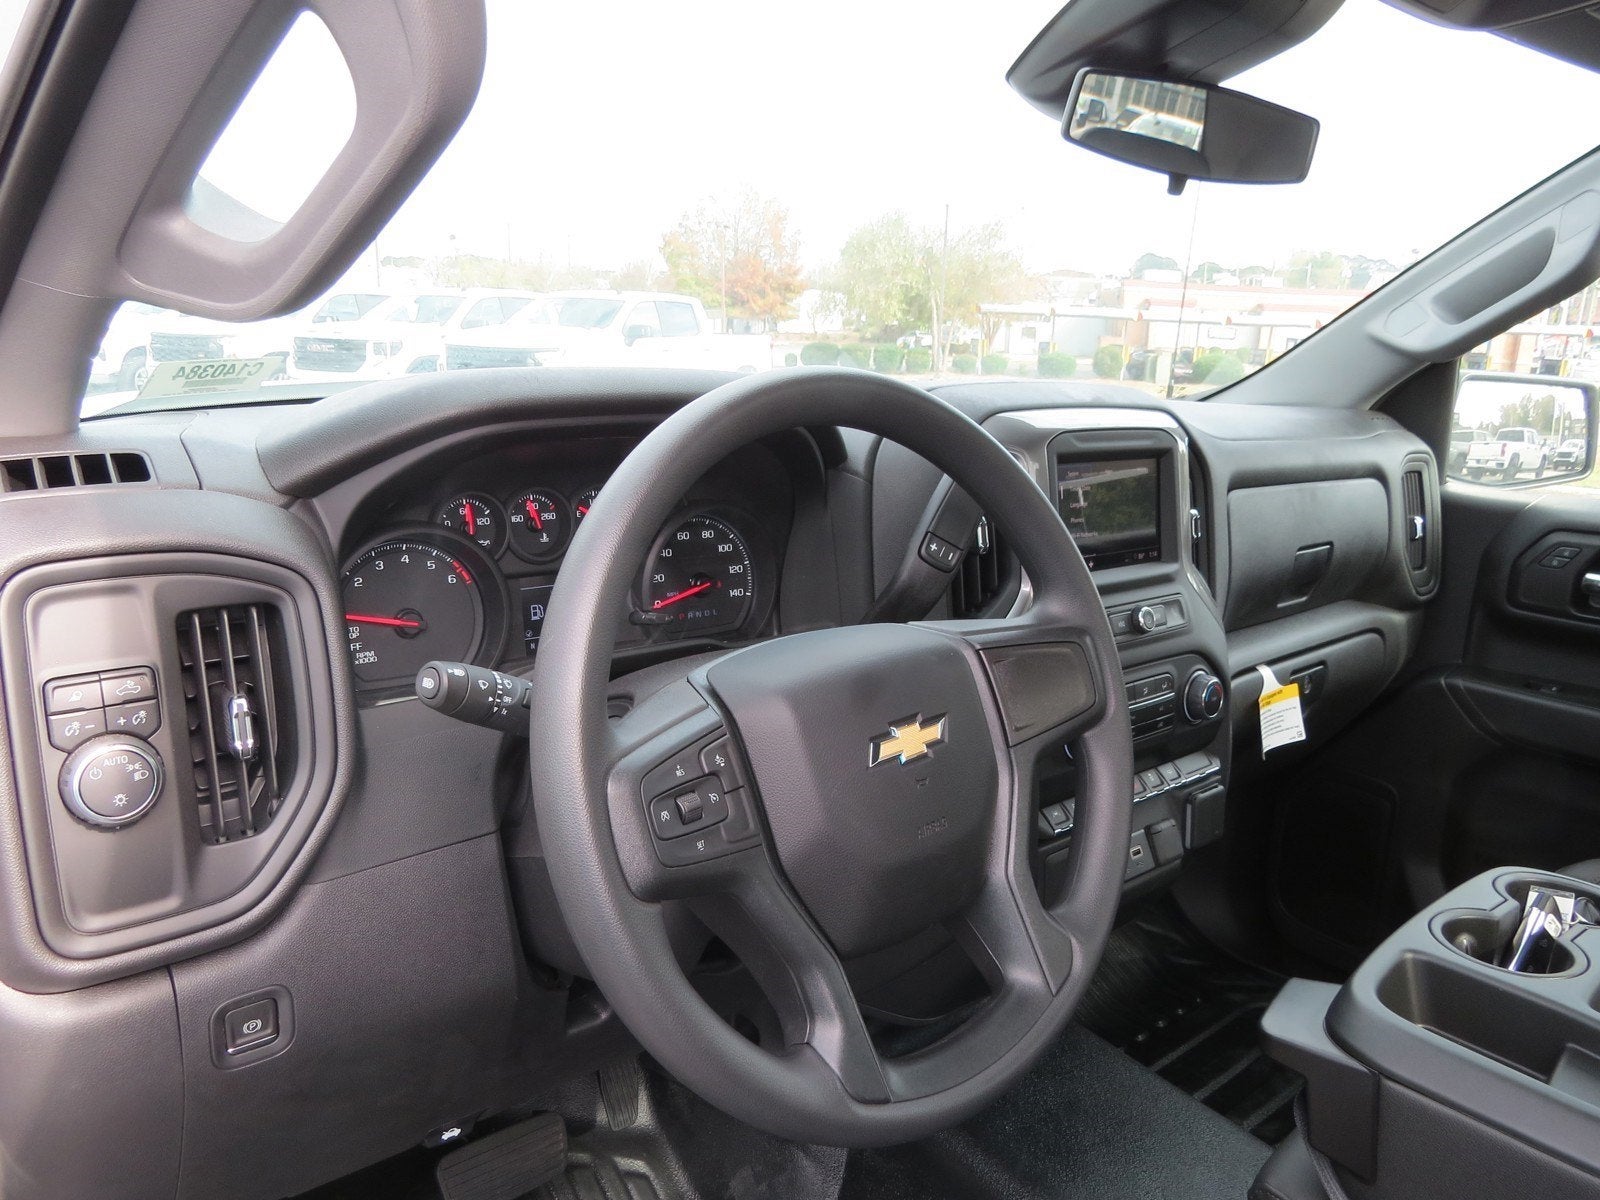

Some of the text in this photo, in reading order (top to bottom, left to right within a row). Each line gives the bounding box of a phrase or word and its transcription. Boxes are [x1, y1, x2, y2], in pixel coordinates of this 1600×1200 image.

[511, 514, 524, 522] 160
[541, 512, 556, 521] 260
[476, 518, 490, 526] 120
[677, 532, 690, 541] 60
[701, 530, 715, 539] 80
[718, 543, 733, 553] 100
[400, 554, 410, 564] 4
[375, 561, 384, 571] 3
[427, 560, 436, 570] 5
[729, 565, 743, 574] 120
[354, 577, 363, 587] 2
[447, 574, 457, 584] 6
[653, 574, 665, 583] 20
[729, 588, 744, 597] 140
[356, 651, 375, 659] RPM
[503, 696, 512, 704] OFF
[103, 755, 129, 767] AUTO
